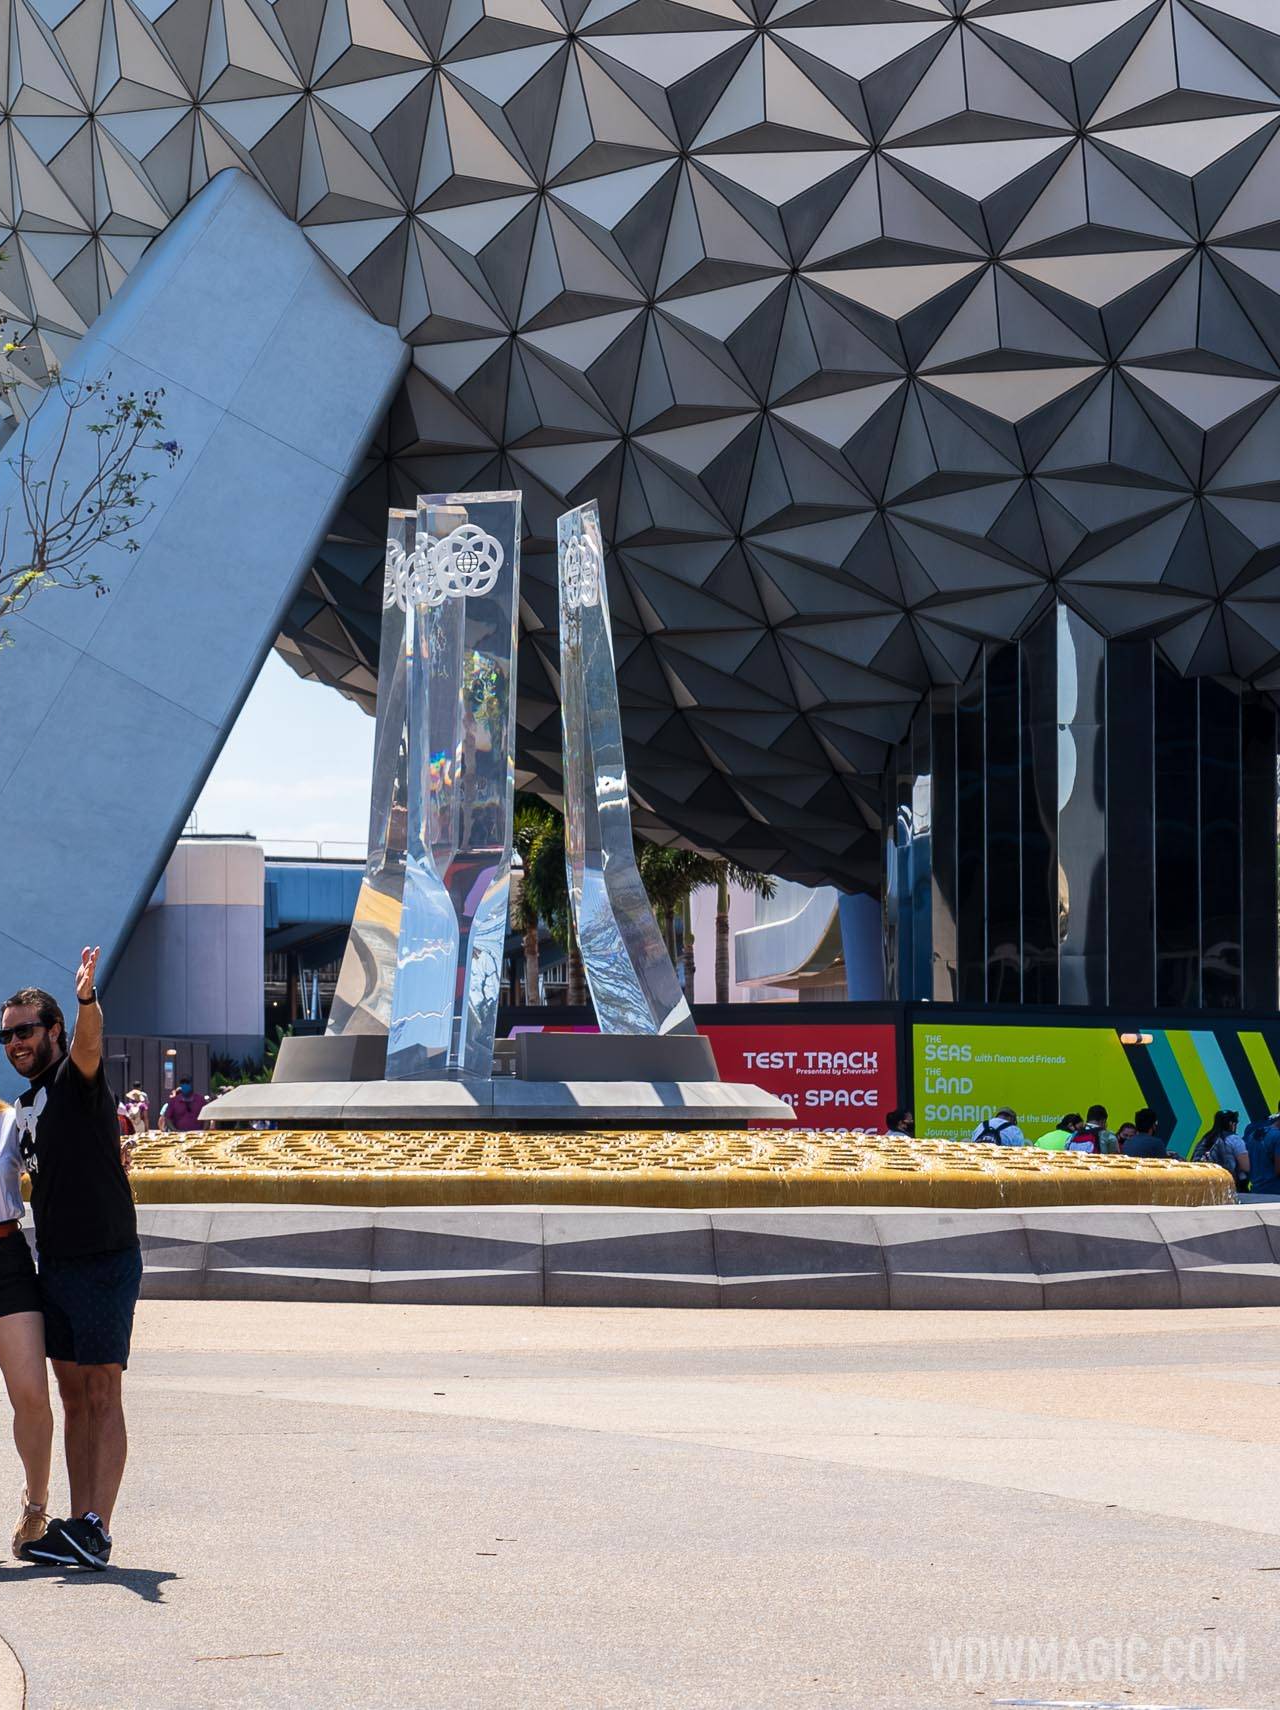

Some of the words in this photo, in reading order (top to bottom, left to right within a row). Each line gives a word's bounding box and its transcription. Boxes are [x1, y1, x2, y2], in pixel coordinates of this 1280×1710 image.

[925, 1035, 941, 1043] THE
[743, 1052, 797, 1069] TEST
[804, 1052, 878, 1069] TRACK
[925, 1045, 972, 1061] SEAS
[975, 1054, 993, 1063] with
[1019, 1055, 1035, 1063] and
[1036, 1055, 1066, 1064] Friends
[832, 1068, 841, 1076] by
[925, 1068, 941, 1076] THE
[925, 1077, 973, 1094] LAND
[805, 1090, 878, 1107] SPACE
[925, 1105, 997, 1122] SOARIN'
[1027, 1113, 1040, 1122] the
[925, 1128, 958, 1139] Journey
